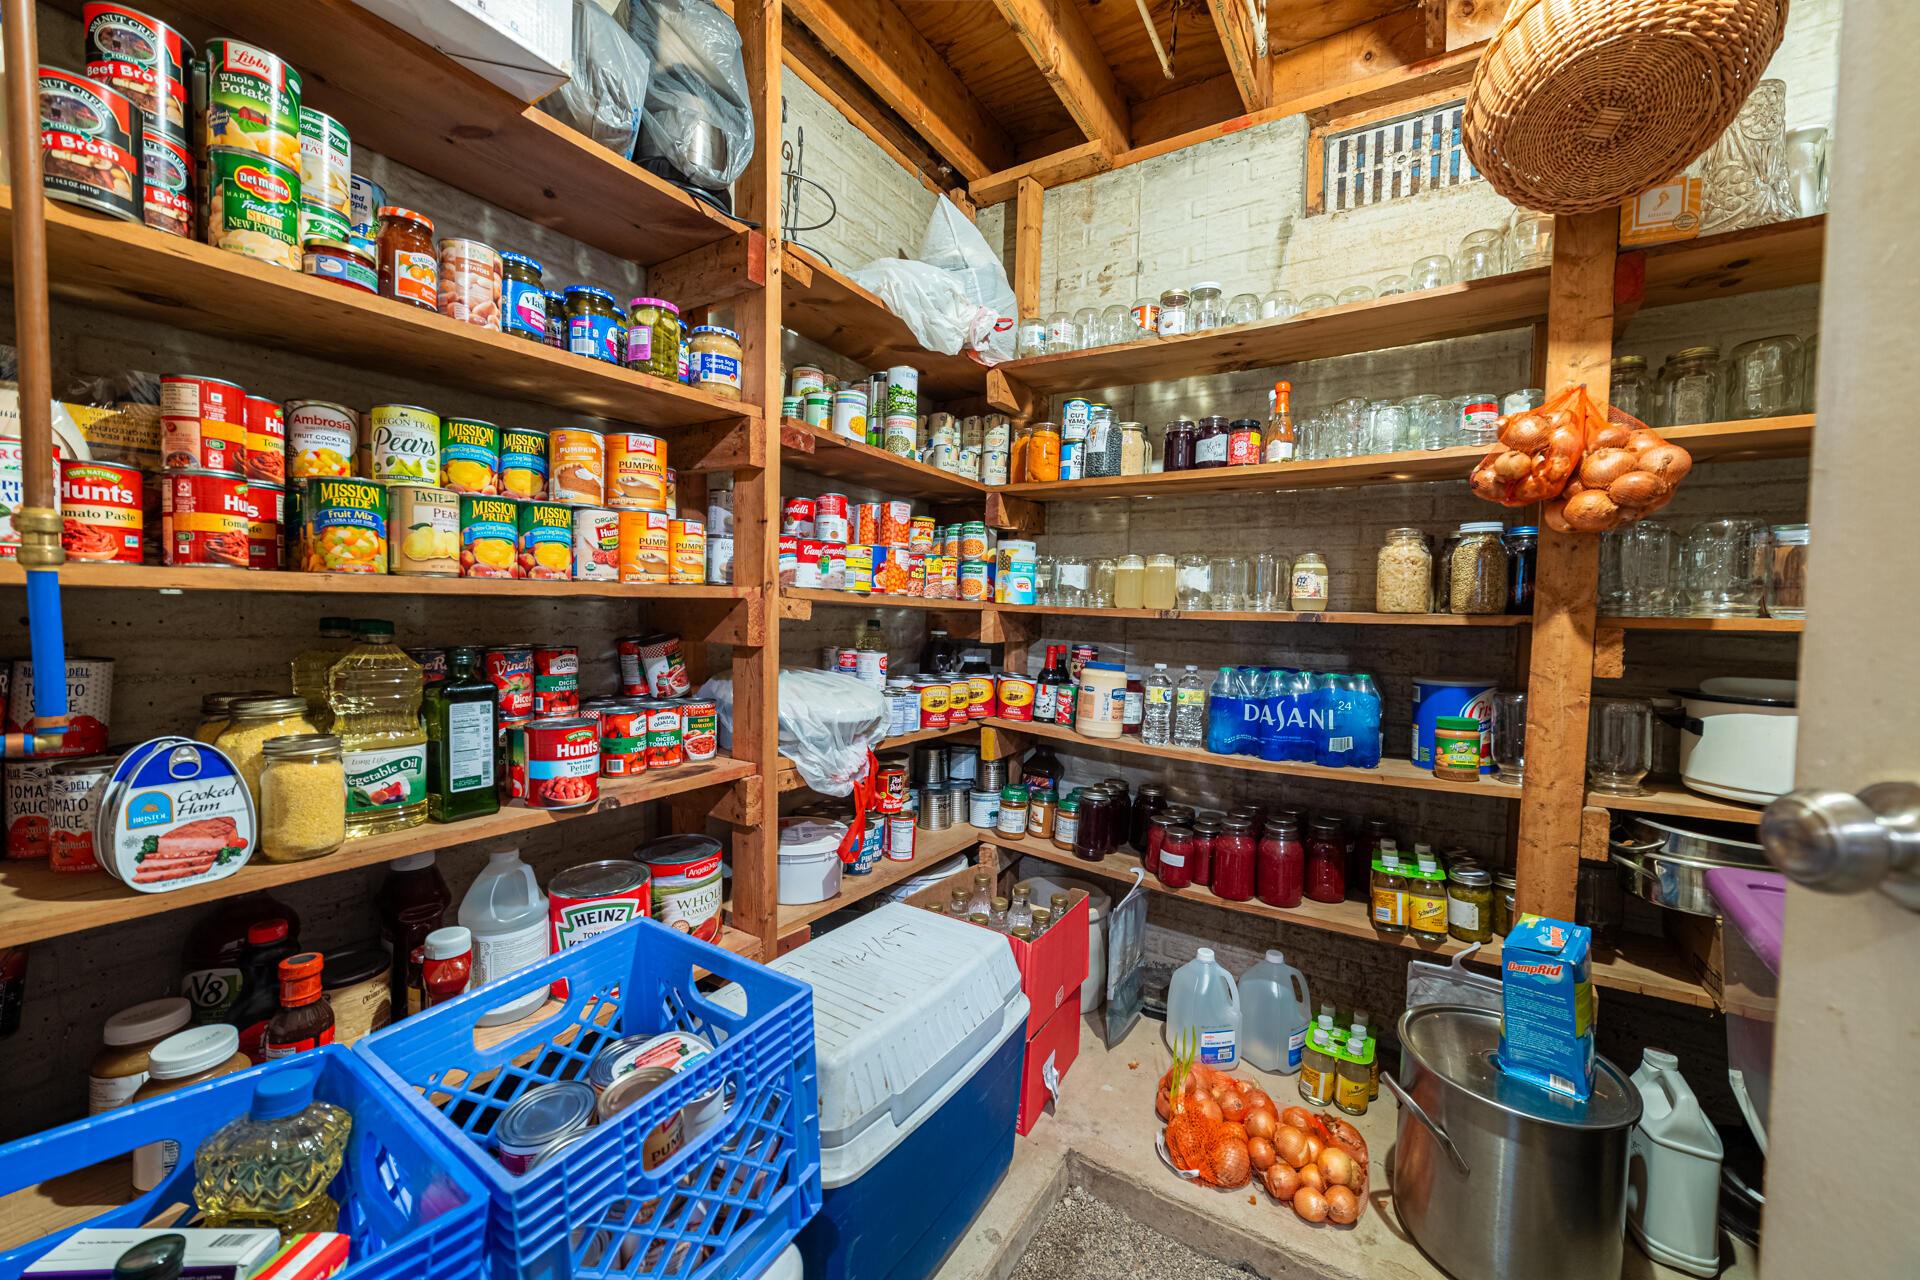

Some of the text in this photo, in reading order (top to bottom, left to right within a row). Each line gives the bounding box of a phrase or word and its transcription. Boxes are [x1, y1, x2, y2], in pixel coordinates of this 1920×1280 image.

[90, 13, 157, 42] WALNUT CREE
[87, 64, 171, 91] Beef Broh
[220, 73, 254, 86] Whole
[39, 79, 68, 91] NUT
[60, 136, 120, 161] Broth
[239, 172, 289, 197] Del Monte
[153, 190, 193, 212] Broth
[226, 191, 250, 199] MADE
[248, 210, 282, 227] SLICED
[228, 216, 295, 244] NEW POTATOES
[461, 263, 490, 275] PTATOES
[525, 296, 545, 312] Vlas
[706, 362, 734, 372] Saerkraut
[293, 414, 351, 431] Ambrosia
[374, 417, 410, 426] OREGON
[448, 422, 494, 445] MISSION
[457, 435, 487, 446] PRIDE
[264, 438, 284, 450] Toma
[374, 426, 436, 456] Pears
[503, 434, 544, 452] MISSION
[510, 446, 538, 455] PRIDE
[619, 461, 662, 472] PUMPKIN
[89, 469, 118, 480] NATURAL
[320, 482, 380, 508] MISSION
[414, 490, 444, 504] TASTE
[332, 497, 371, 509] PRIDE
[60, 508, 135, 522] omato Paste
[327, 510, 373, 521] Fruit Mix
[472, 500, 516, 521] MISSION
[533, 506, 571, 527] MISSION
[222, 518, 248, 529] Toma
[482, 513, 511, 523] PRIDE
[543, 518, 567, 528] PRIDE
[639, 537, 668, 545] PUMP
[68, 668, 90, 678] DELL
[513, 693, 532, 704] Diced
[1244, 700, 1352, 732] DASANI 24
[400, 758, 417, 769] Oil
[570, 763, 591, 772] Petite
[10, 785, 49, 799] TOMA
[70, 780, 92, 791] DELL
[178, 781, 239, 804] Cooked
[13, 800, 47, 814] SAUC
[178, 802, 220, 817] Ham
[133, 813, 166, 824] BRISTOL
[574, 909, 626, 928] HEINZ
[1508, 961, 1562, 976] DampRid
[192, 972, 223, 1004] V8
